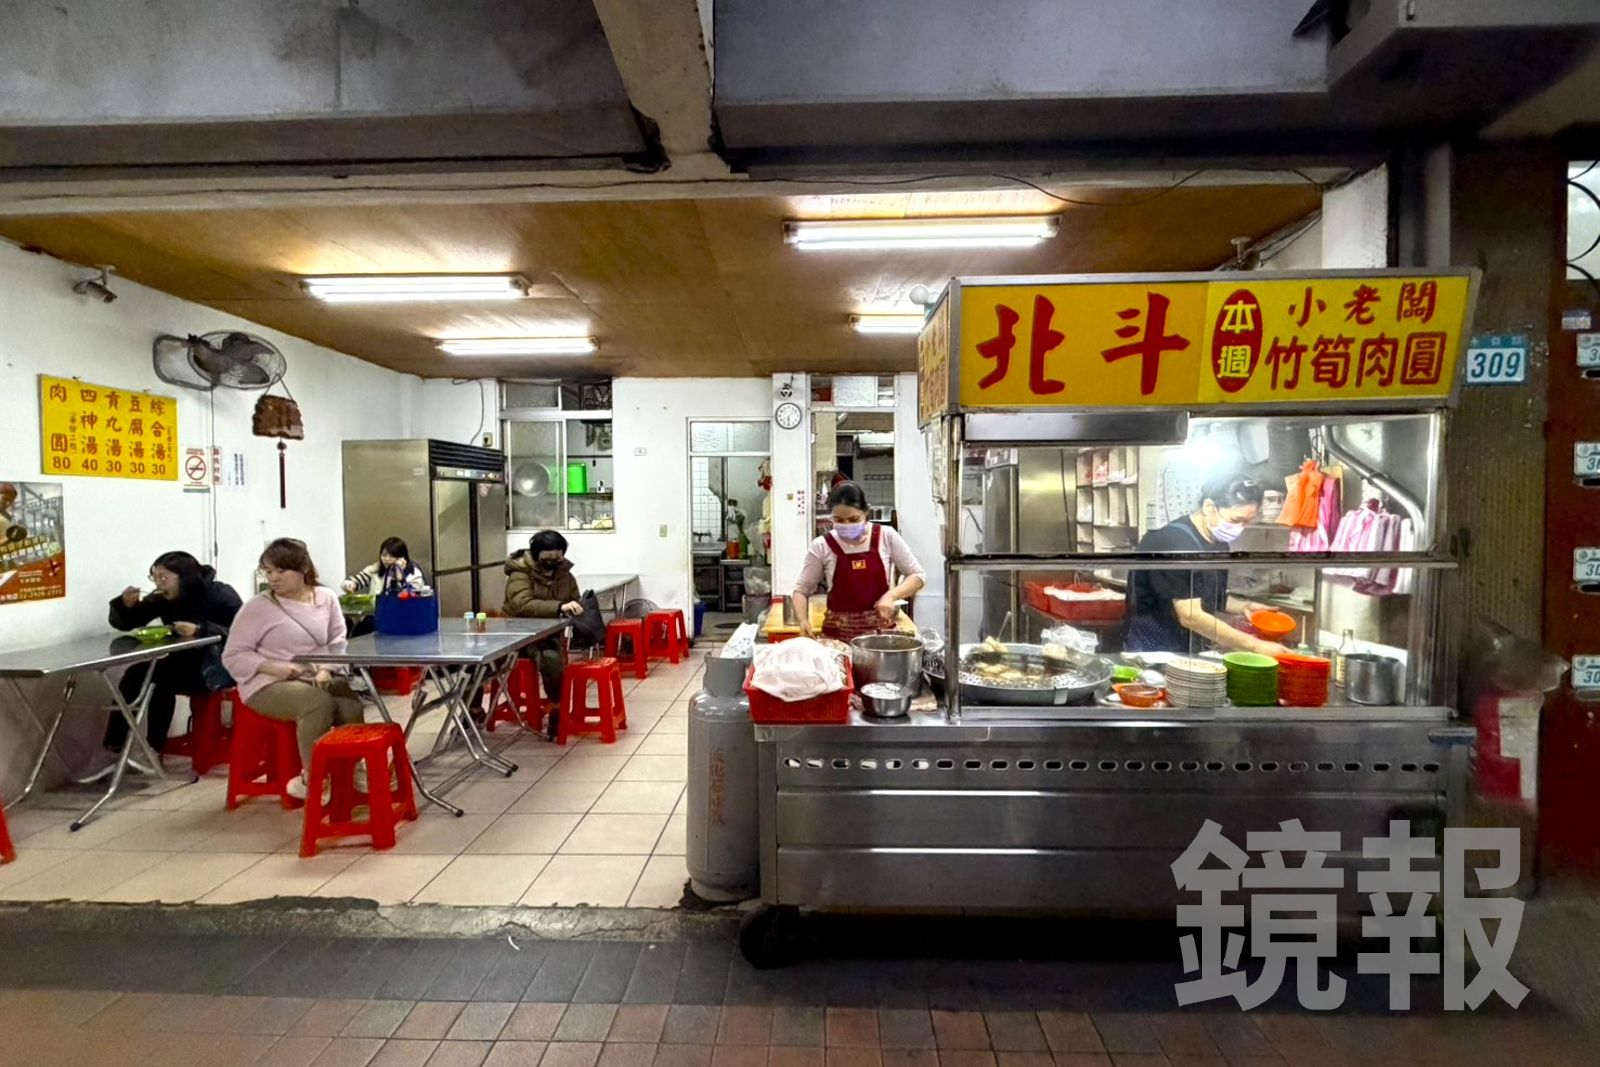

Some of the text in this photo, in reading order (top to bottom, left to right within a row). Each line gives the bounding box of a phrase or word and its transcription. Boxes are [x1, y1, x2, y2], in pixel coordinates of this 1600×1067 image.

[1288, 280, 1438, 327] 小老闆
[976, 291, 1191, 395] 北斗
[1217, 300, 1257, 378] 本週
[1264, 332, 1447, 390] 竹筍肉圓
[1470, 352, 1521, 378] 309
[50, 383, 68, 453] 肉圓
[80, 388, 98, 455] 四神湯
[105, 390, 122, 457] 貢丸湯
[128, 395, 144, 459] 豆腐湯
[150, 399, 166, 461] 綜合湯
[52, 456, 71, 469] 80
[81, 458, 98, 471] 40
[106, 460, 122, 472] 30
[130, 462, 145, 474] 30
[151, 464, 166, 475] 30
